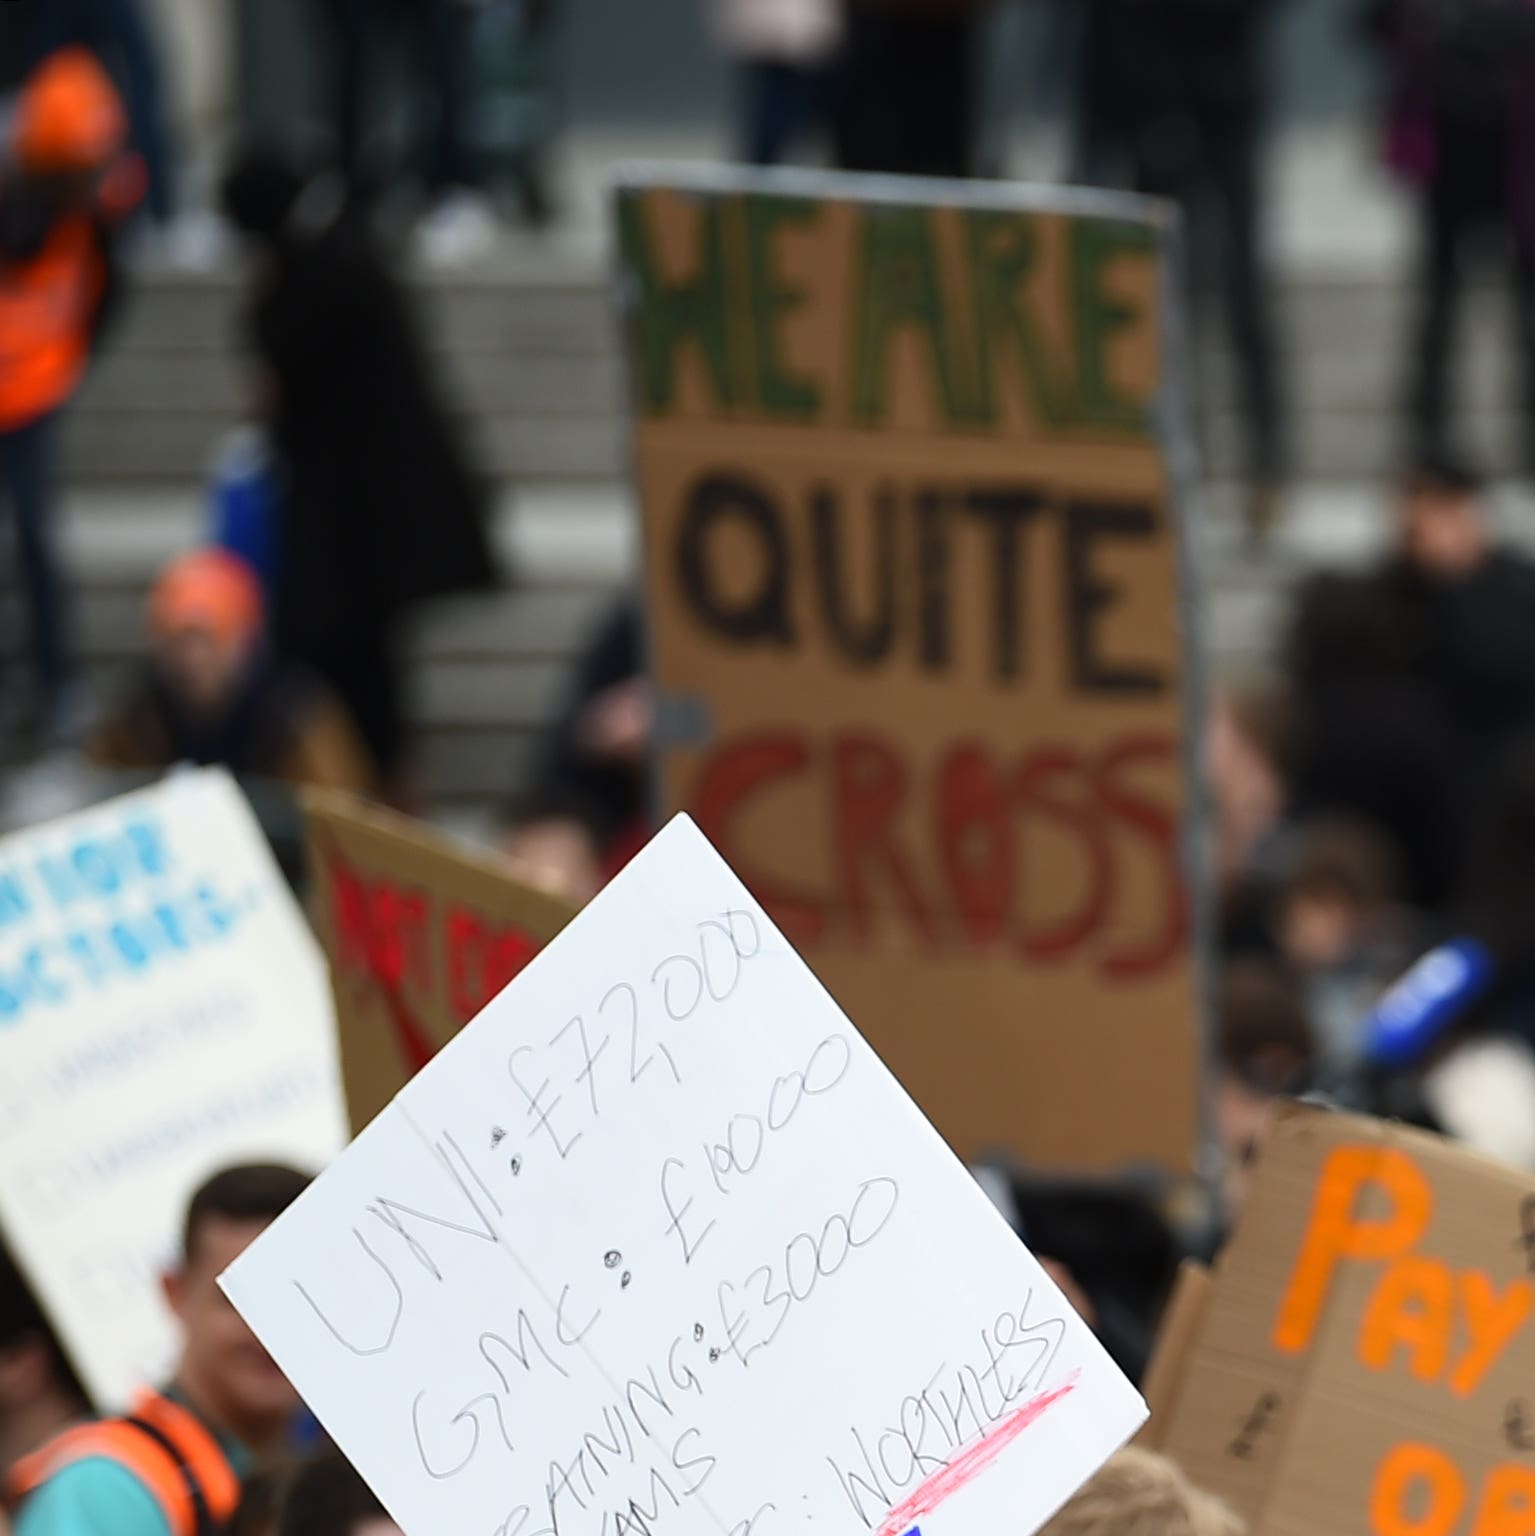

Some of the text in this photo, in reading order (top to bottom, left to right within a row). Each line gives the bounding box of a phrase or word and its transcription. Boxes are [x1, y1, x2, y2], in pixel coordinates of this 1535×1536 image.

[617, 190, 1158, 440] WE ARE
[676, 467, 1170, 697] QUITE
[694, 720, 1192, 985] CROSS
